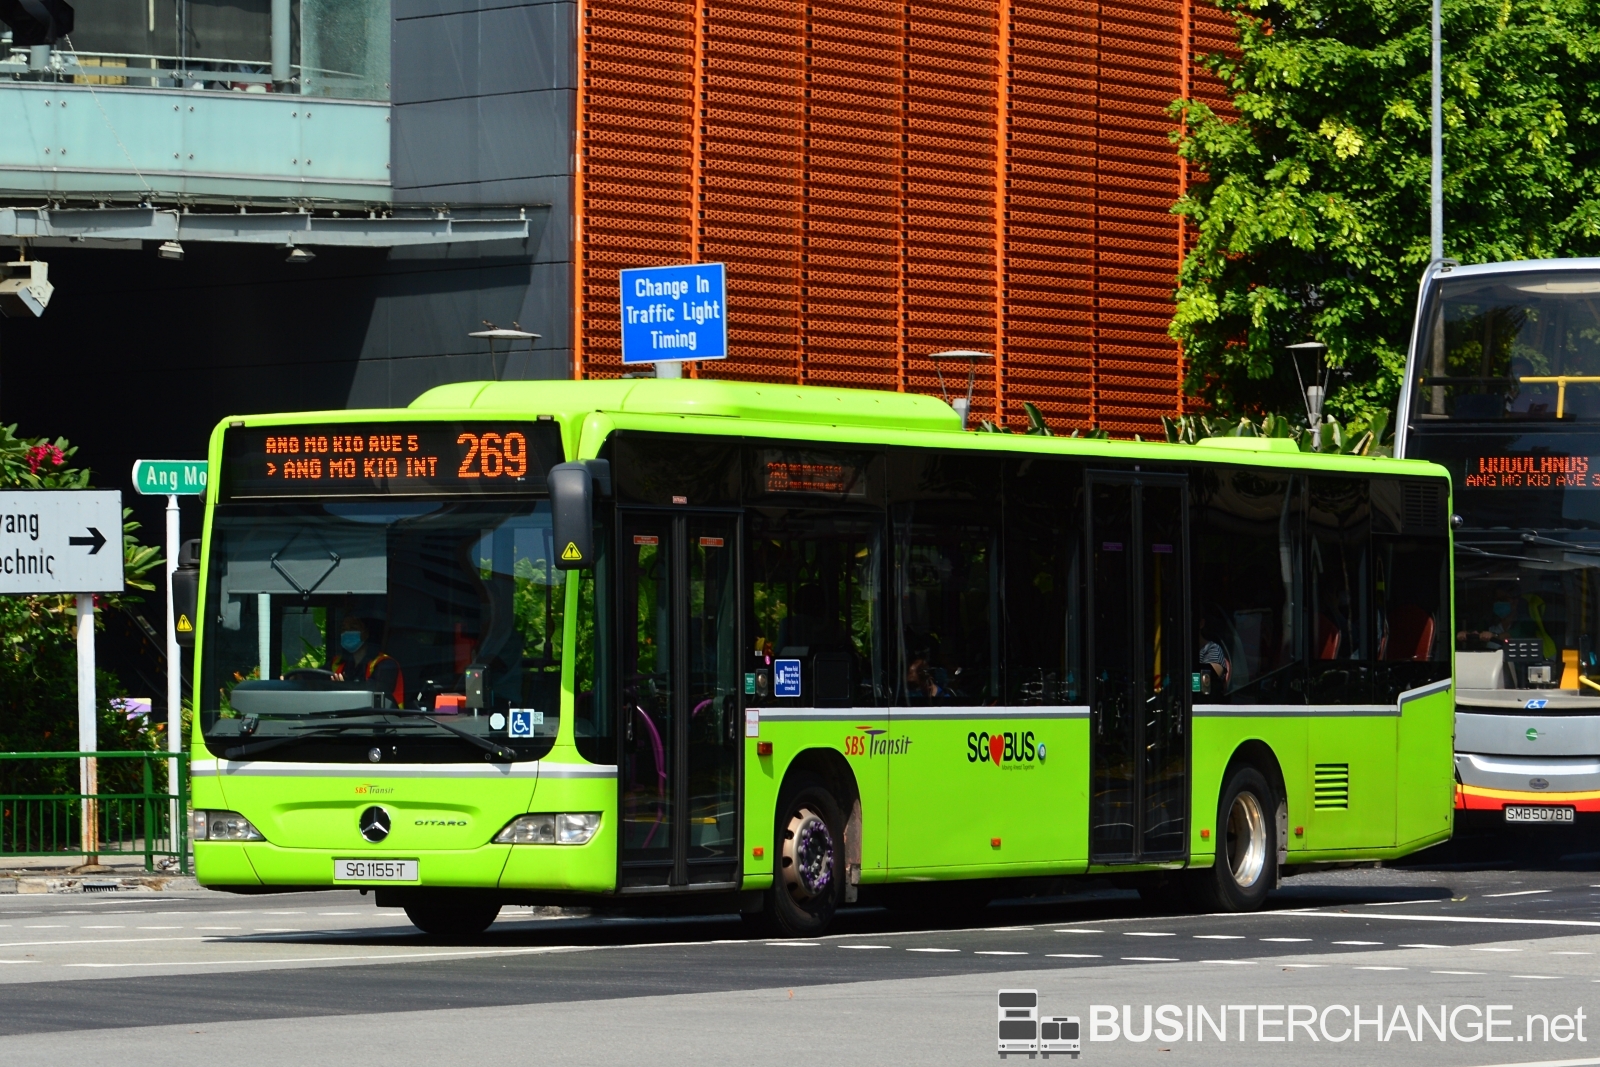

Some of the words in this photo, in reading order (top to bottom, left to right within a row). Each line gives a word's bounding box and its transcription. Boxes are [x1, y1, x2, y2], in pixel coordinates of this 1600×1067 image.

[635, 278, 689, 301] Change
[696, 274, 710, 294] In
[626, 303, 676, 325] Traffic
[683, 300, 720, 326] Light
[650, 329, 697, 351] Timing
[265, 436, 299, 454] ANG
[304, 436, 328, 453] MO
[333, 435, 364, 453] KIO
[368, 435, 402, 452] AVE
[407, 435, 419, 452] 5
[456, 431, 527, 478] 269
[146, 465, 178, 491] Ang
[184, 465, 207, 486] Mo
[283, 458, 322, 479] ANG
[329, 457, 356, 478] MO
[363, 457, 398, 478] KIO
[405, 456, 438, 477] INT
[1466, 474, 1497, 487] ANG
[1501, 474, 1522, 487] MO
[1527, 474, 1551, 487] KIO
[1556, 473, 1587, 487] AVE
[844, 735, 865, 756] SBS
[864, 729, 913, 760] Transit
[355, 786, 368, 794] SBS
[367, 784, 395, 795] Transit
[1507, 808, 1573, 821] SMB5078D
